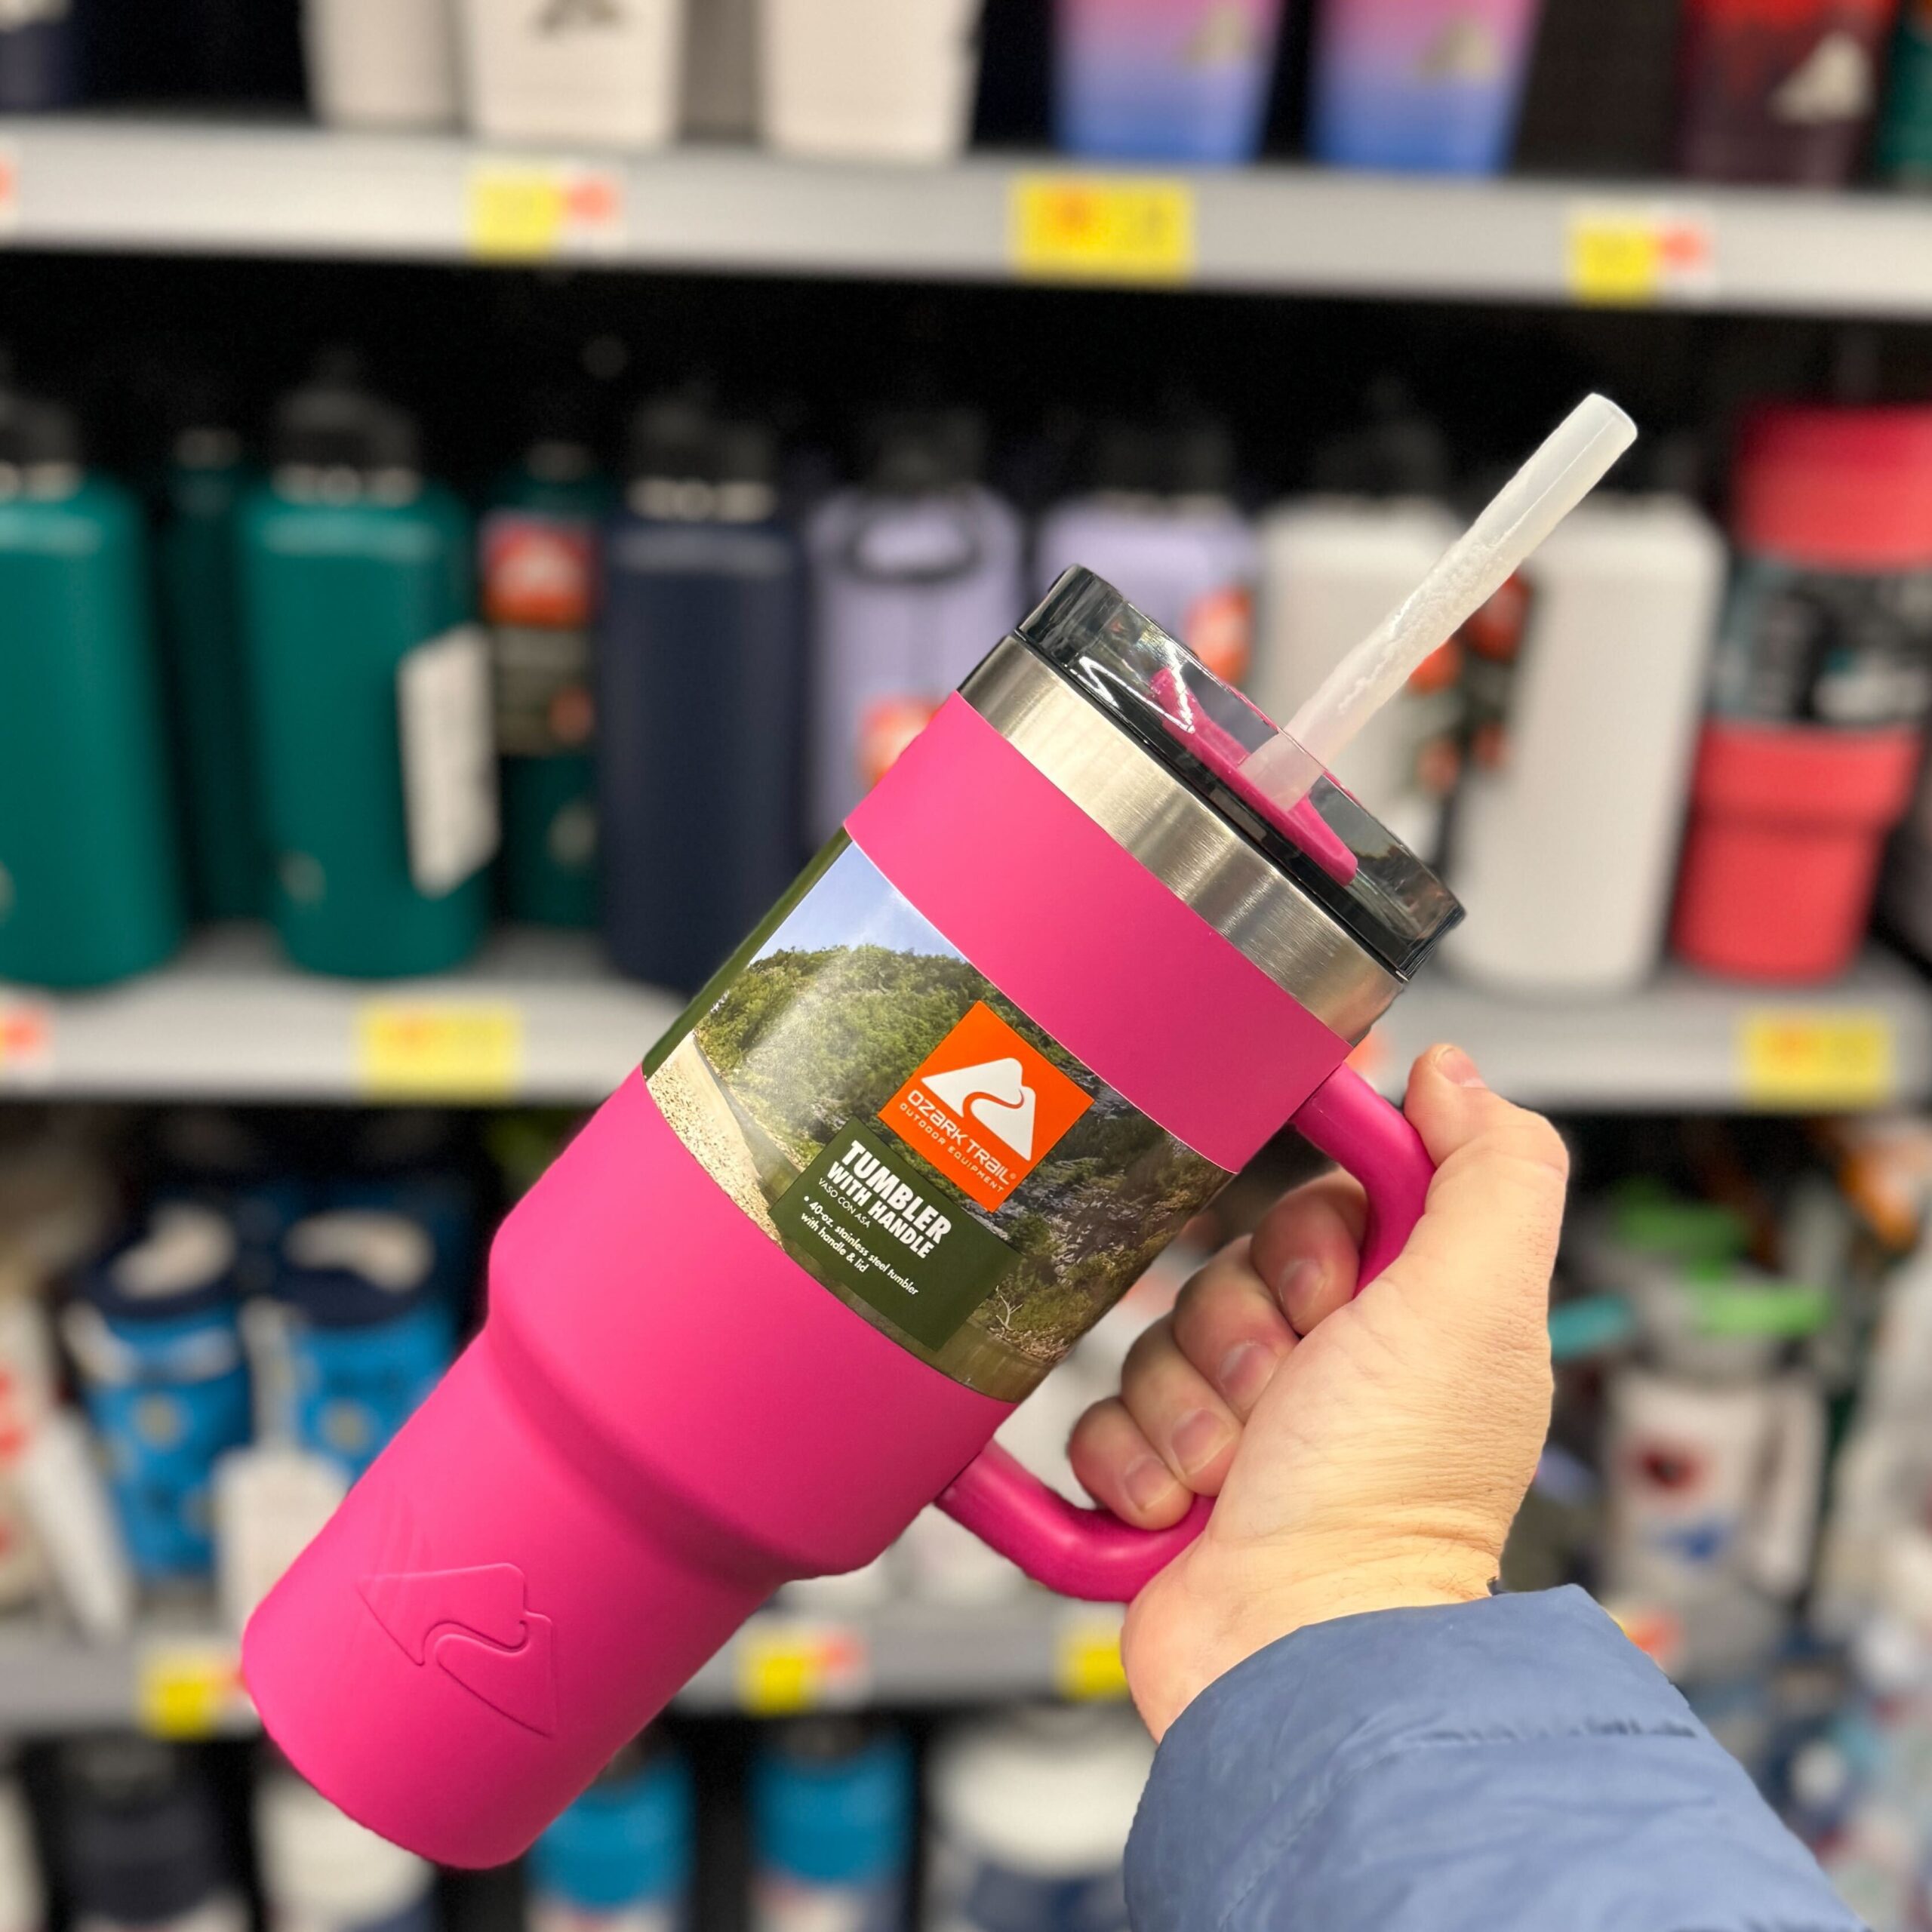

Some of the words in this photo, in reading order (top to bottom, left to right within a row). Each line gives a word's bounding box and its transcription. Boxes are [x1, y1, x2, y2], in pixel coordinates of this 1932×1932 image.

[841, 1140, 952, 1244] TUMBLER
[900, 1103, 946, 1145] OUTDOOR
[947, 1146, 1004, 1192] EQUIPMENT
[801, 1212, 820, 1232] with
[818, 1227, 846, 1256] handle
[845, 1253, 855, 1263] &
[854, 1258, 869, 1272] lid
[809, 1201, 834, 1227] 40-oz.
[834, 1226, 869, 1257] stainless
[868, 1254, 891, 1272] steel
[888, 1269, 919, 1295] tumbler
[818, 1178, 838, 1198] VASO
[837, 1196, 857, 1214] CON
[854, 1212, 871, 1229] ASA
[827, 1161, 872, 1207] WITH
[867, 1200, 935, 1259] HANDLE
